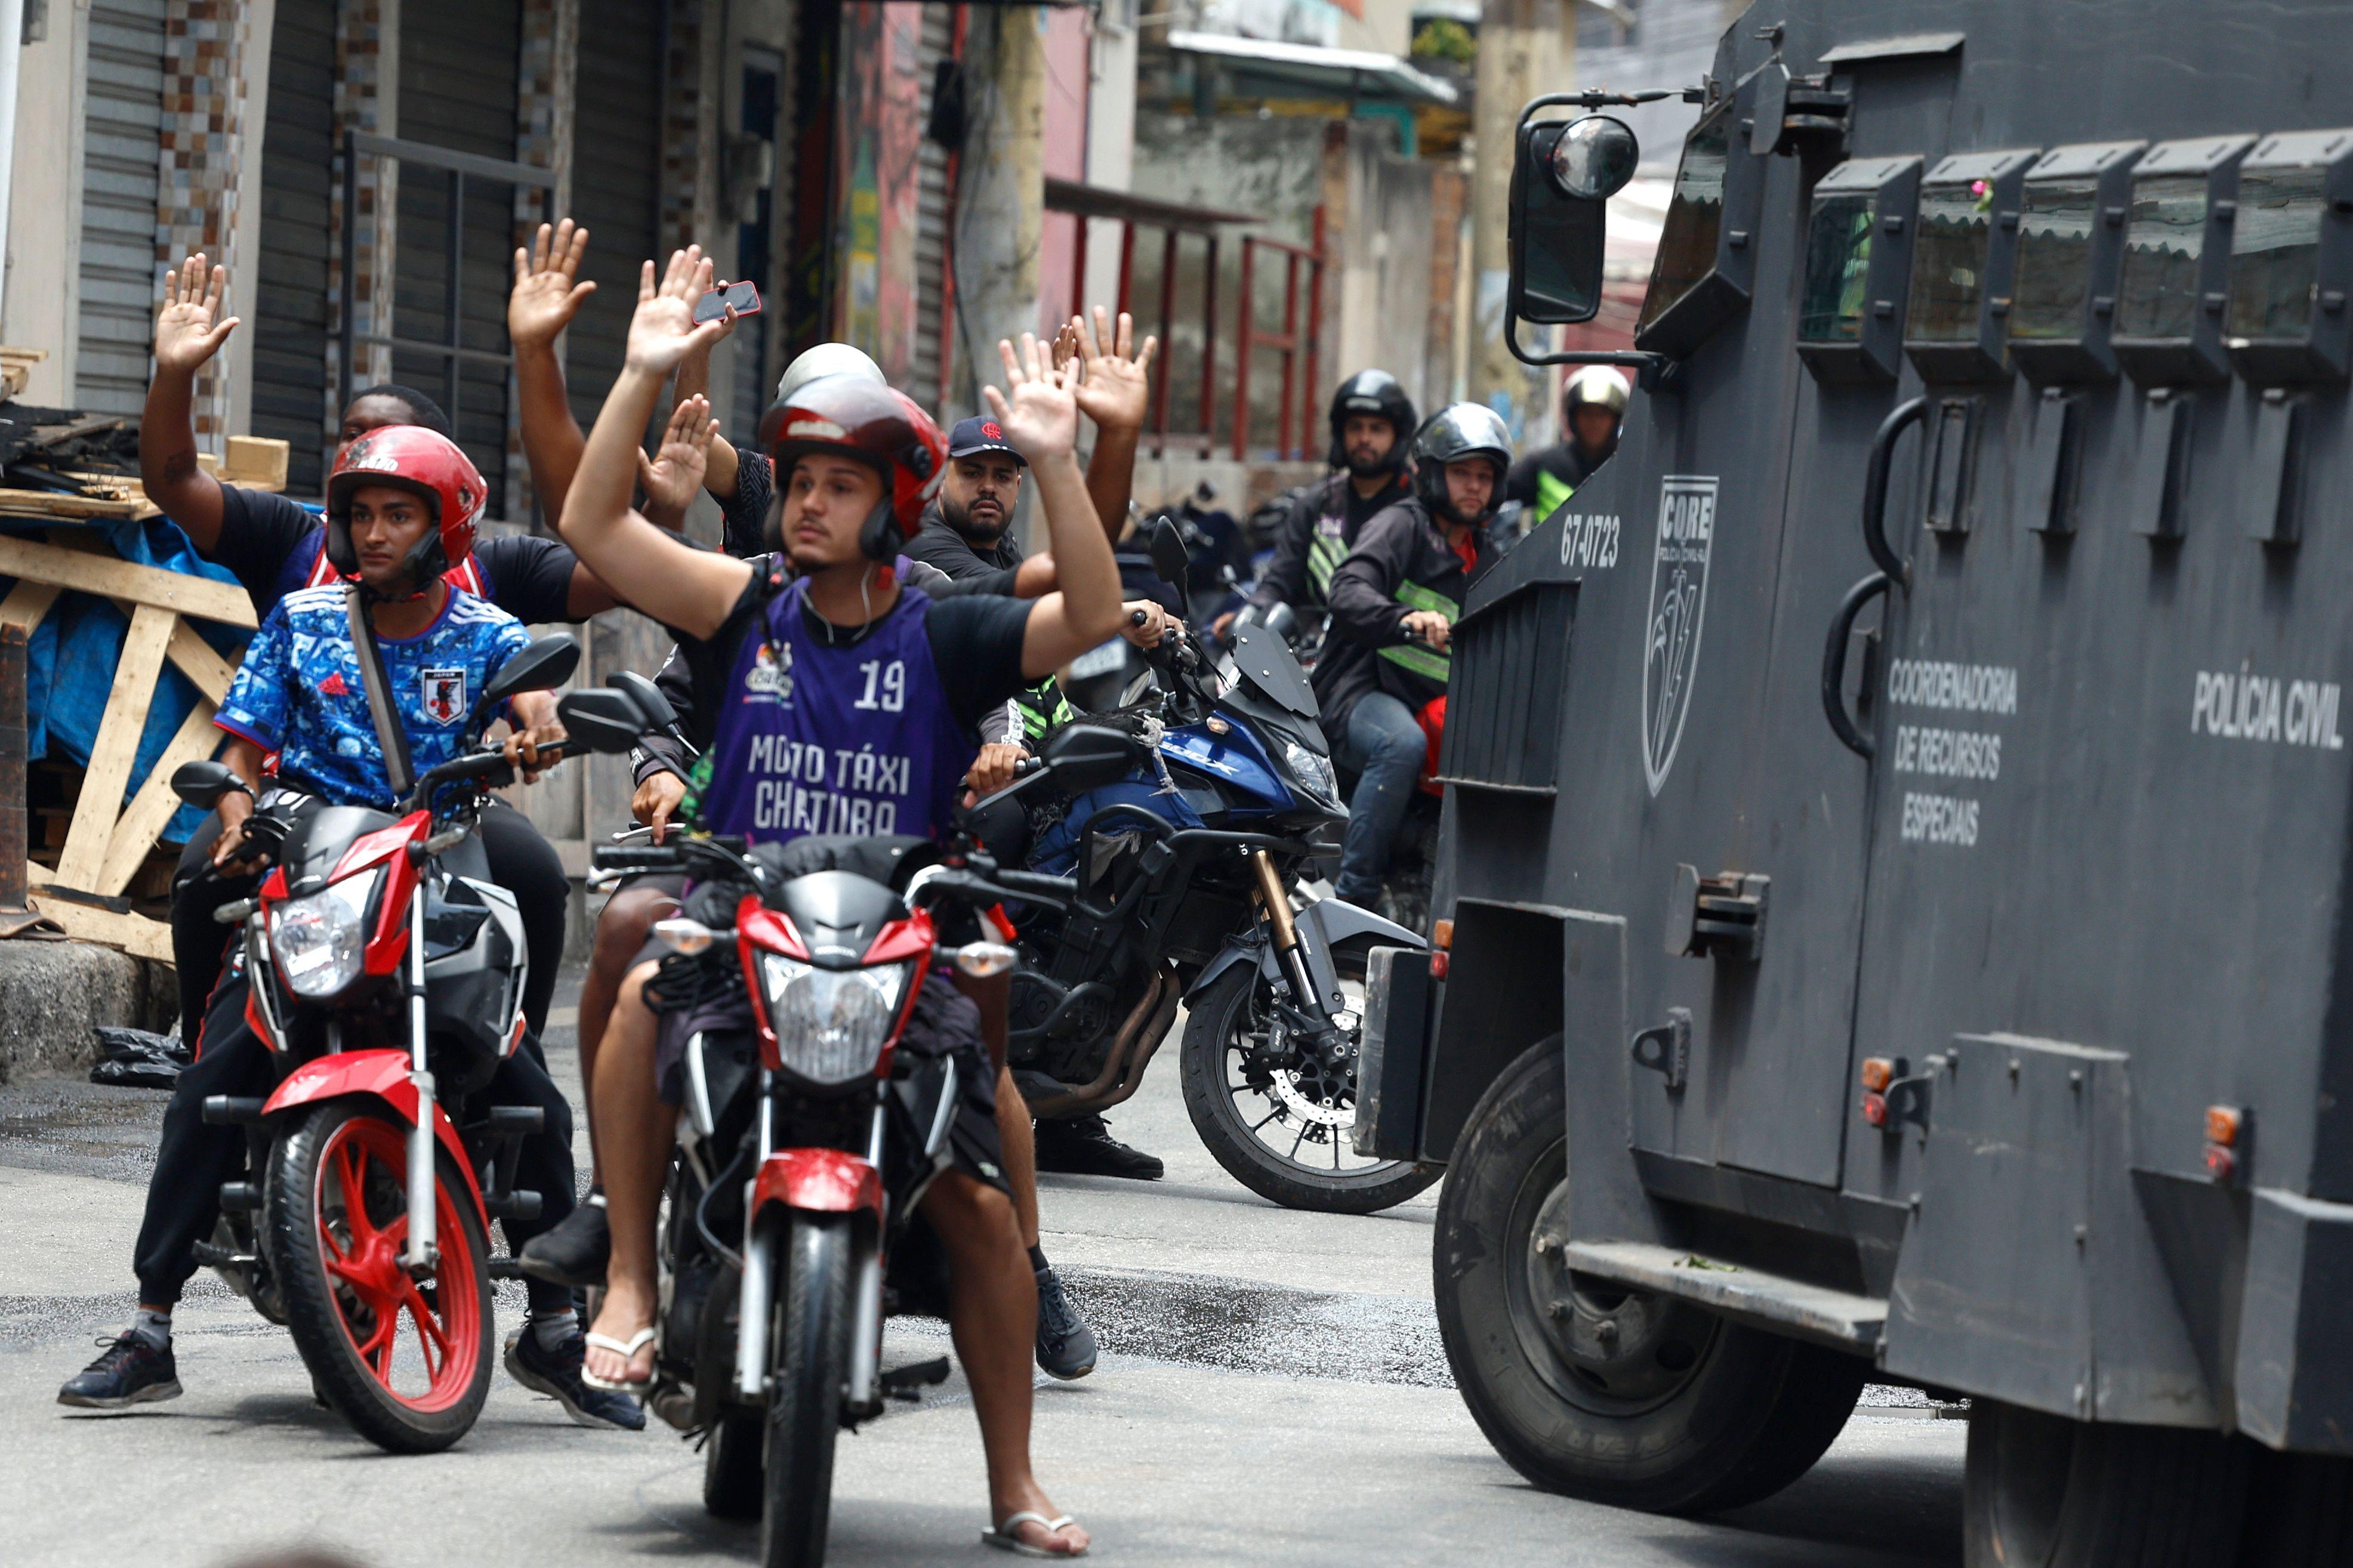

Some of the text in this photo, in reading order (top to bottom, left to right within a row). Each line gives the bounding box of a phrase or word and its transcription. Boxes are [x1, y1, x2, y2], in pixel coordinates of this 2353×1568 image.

[1561, 514, 1620, 567] 67-0723
[1662, 494, 1712, 539] CORE
[853, 659, 906, 713] 19
[1888, 658, 2017, 714] COORDENADORIA
[2191, 658, 2343, 751] POLÍCIA CIVIL
[748, 734, 911, 797] MOTO TÁXI
[1894, 724, 2002, 781] DE RECURSOS
[1901, 792, 1980, 847] ESPECIAIS
